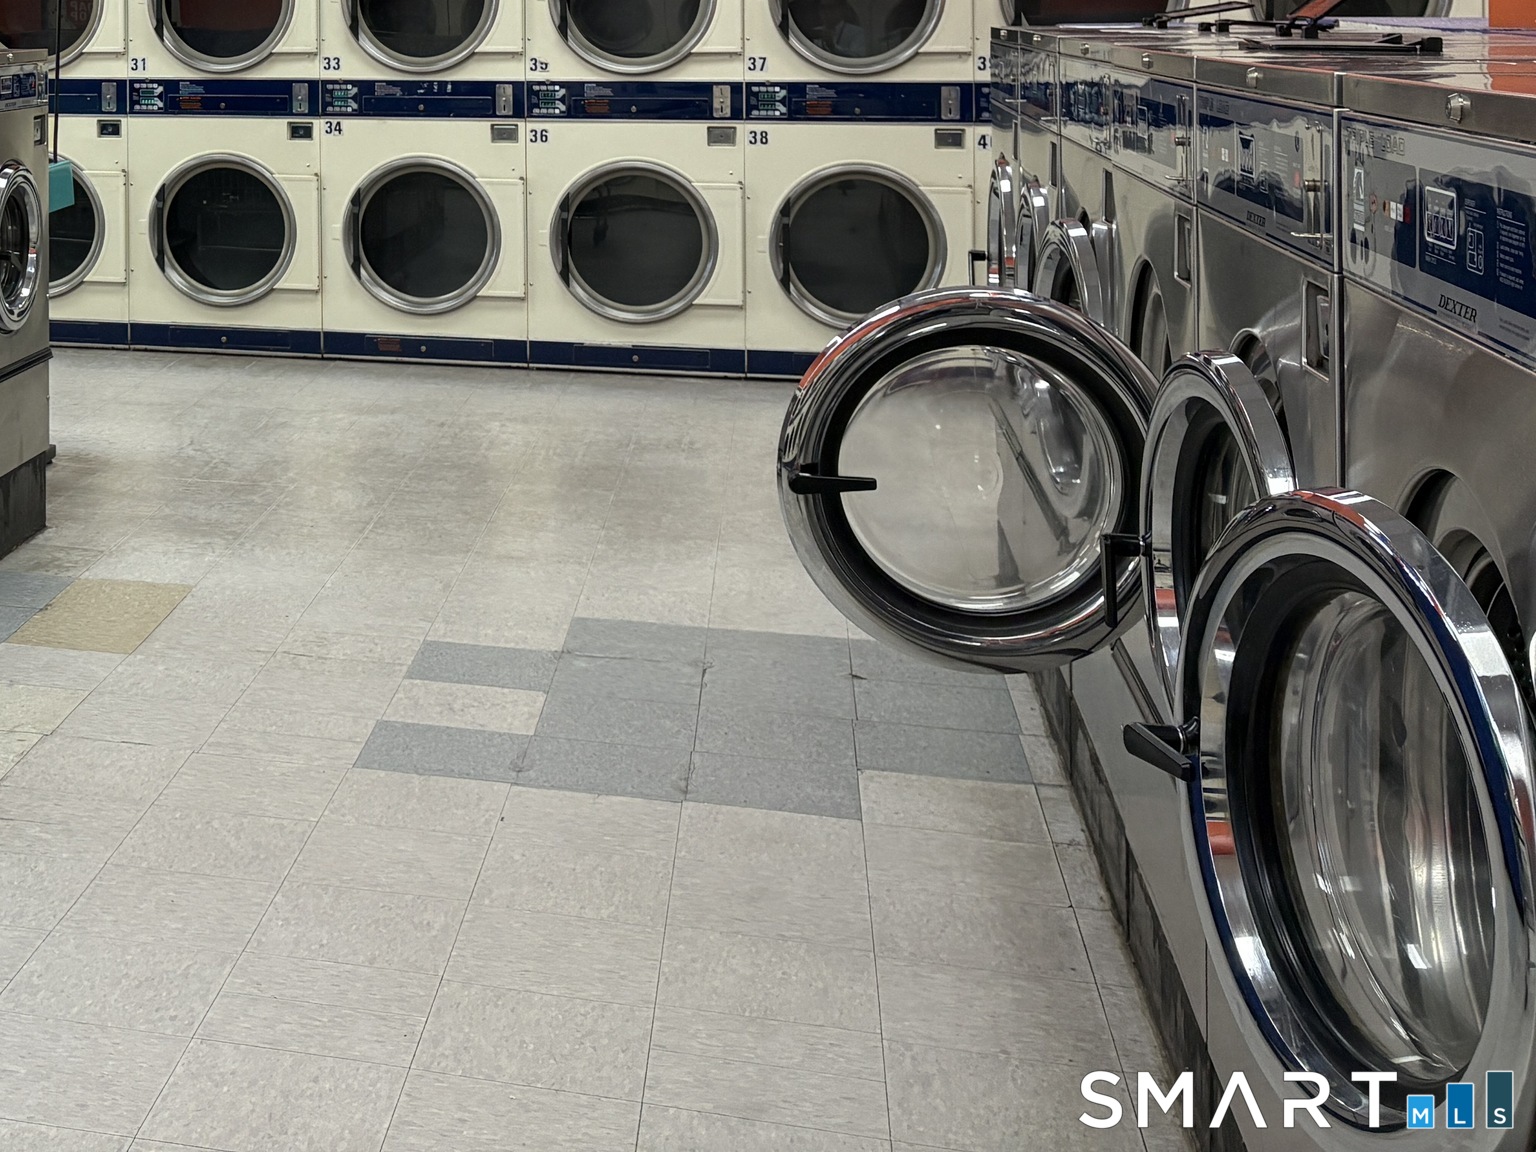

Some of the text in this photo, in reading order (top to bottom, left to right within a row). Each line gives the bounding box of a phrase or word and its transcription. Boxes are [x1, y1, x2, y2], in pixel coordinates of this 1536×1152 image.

[130, 58, 147, 71] 31
[323, 57, 341, 71] 33
[748, 57, 767, 71] 37
[977, 56, 992, 71] 3
[324, 121, 343, 135] 34
[529, 129, 549, 143] 36
[749, 131, 769, 145] 38
[977, 134, 992, 149] 4
[1438, 293, 1478, 324] DEXTER
